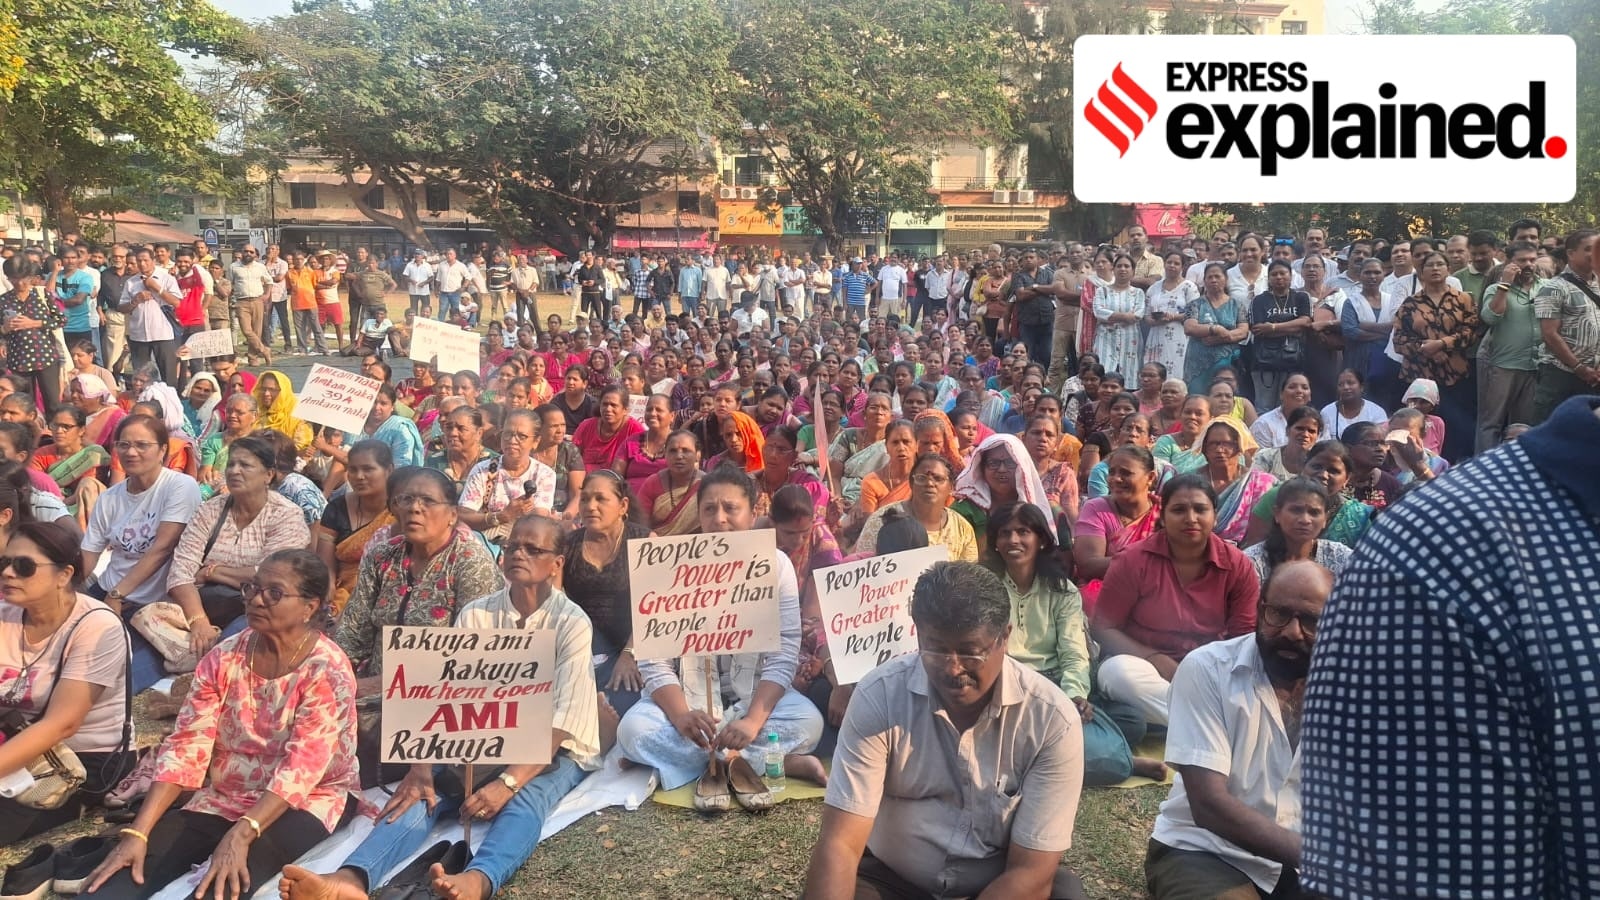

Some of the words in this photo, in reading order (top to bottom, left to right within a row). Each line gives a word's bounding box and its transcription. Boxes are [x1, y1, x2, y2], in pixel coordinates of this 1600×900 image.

[633, 535, 730, 571] People's
[745, 553, 771, 580] is
[825, 556, 898, 595] People's
[638, 587, 727, 615] Greater
[730, 582, 774, 605] than
[858, 578, 908, 608] Power
[641, 612, 706, 641] People
[717, 610, 737, 630] in
[830, 604, 900, 636] Greater
[387, 627, 479, 657] Rakuya
[484, 631, 535, 651] ami
[844, 622, 905, 656] People
[386, 663, 487, 700] Amchem
[439, 658, 539, 684] Rakuya
[421, 701, 519, 732] AMI
[388, 730, 505, 764] Rakuya
